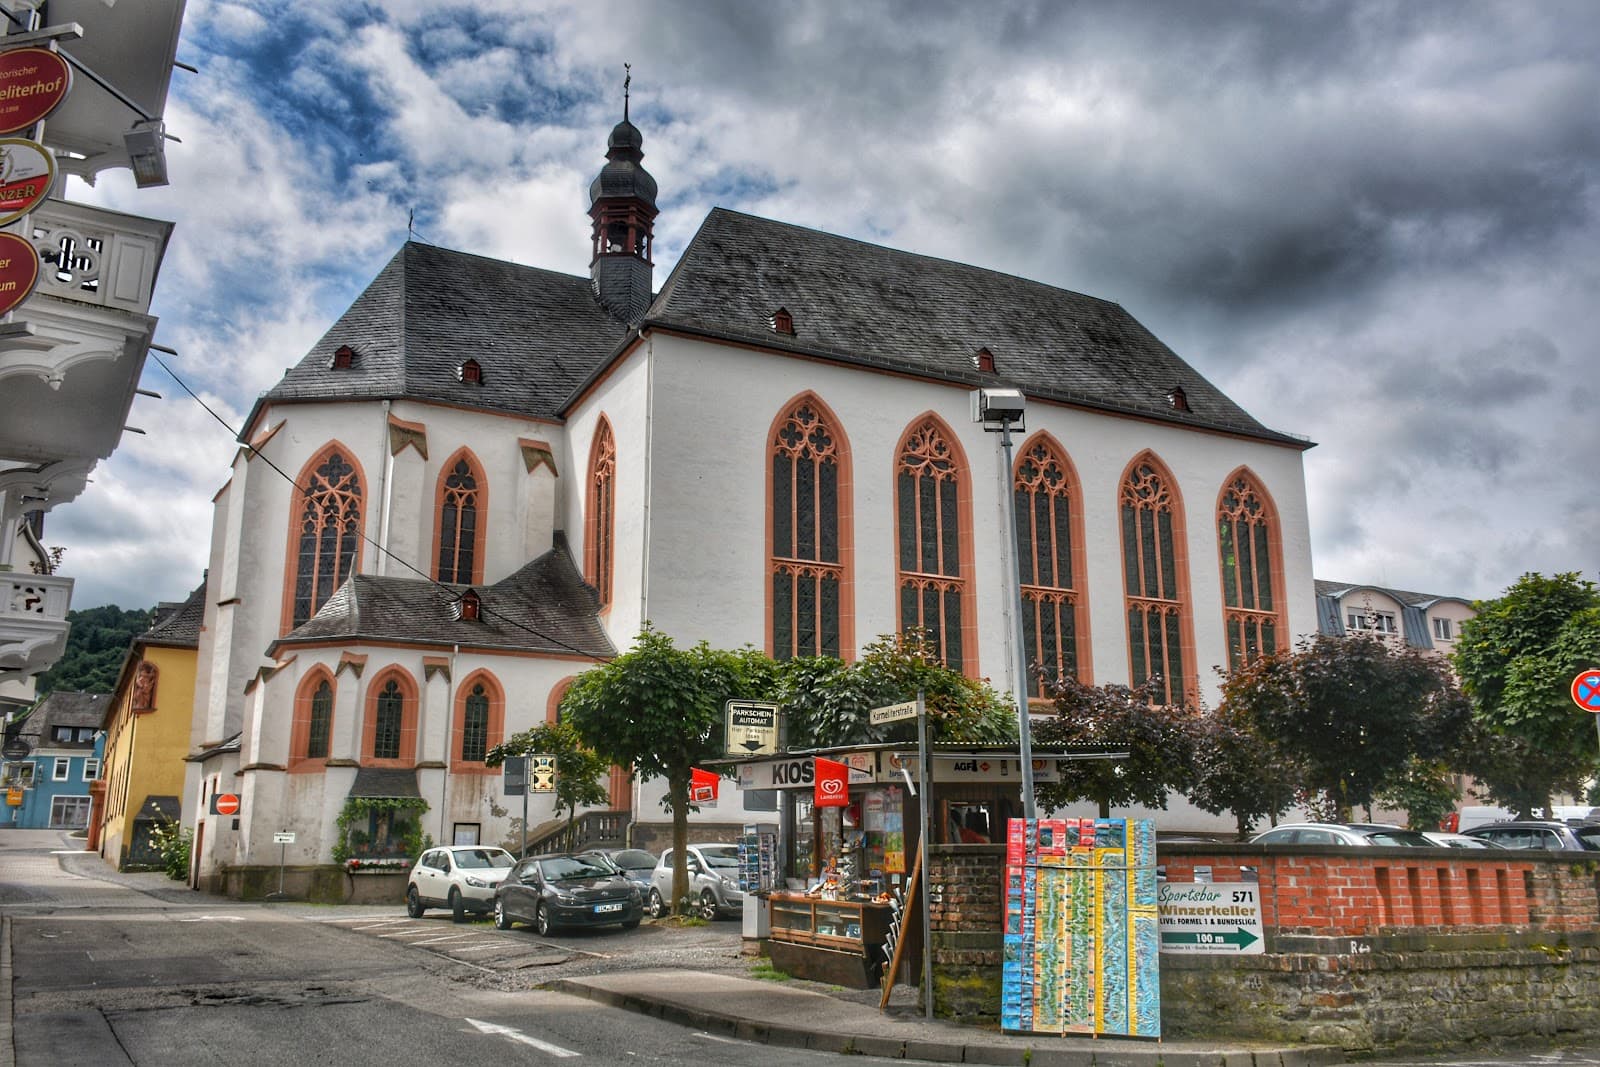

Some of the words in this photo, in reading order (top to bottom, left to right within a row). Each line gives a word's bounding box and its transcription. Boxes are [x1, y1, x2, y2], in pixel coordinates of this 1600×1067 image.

[0, 77, 62, 99] eliterhof
[872, 705, 913, 720] Karmeliterstraße
[739, 717, 767, 725] AUTOMAT
[954, 762, 977, 771] AGF
[1158, 885, 1222, 904] Sportsbar
[1232, 891, 1253, 902] 571
[1157, 905, 1256, 916] Winzerkeller
[1217, 918, 1257, 926] BUNDESLIGA
[1196, 933, 1213, 943] 100
[1215, 935, 1224, 943] m
